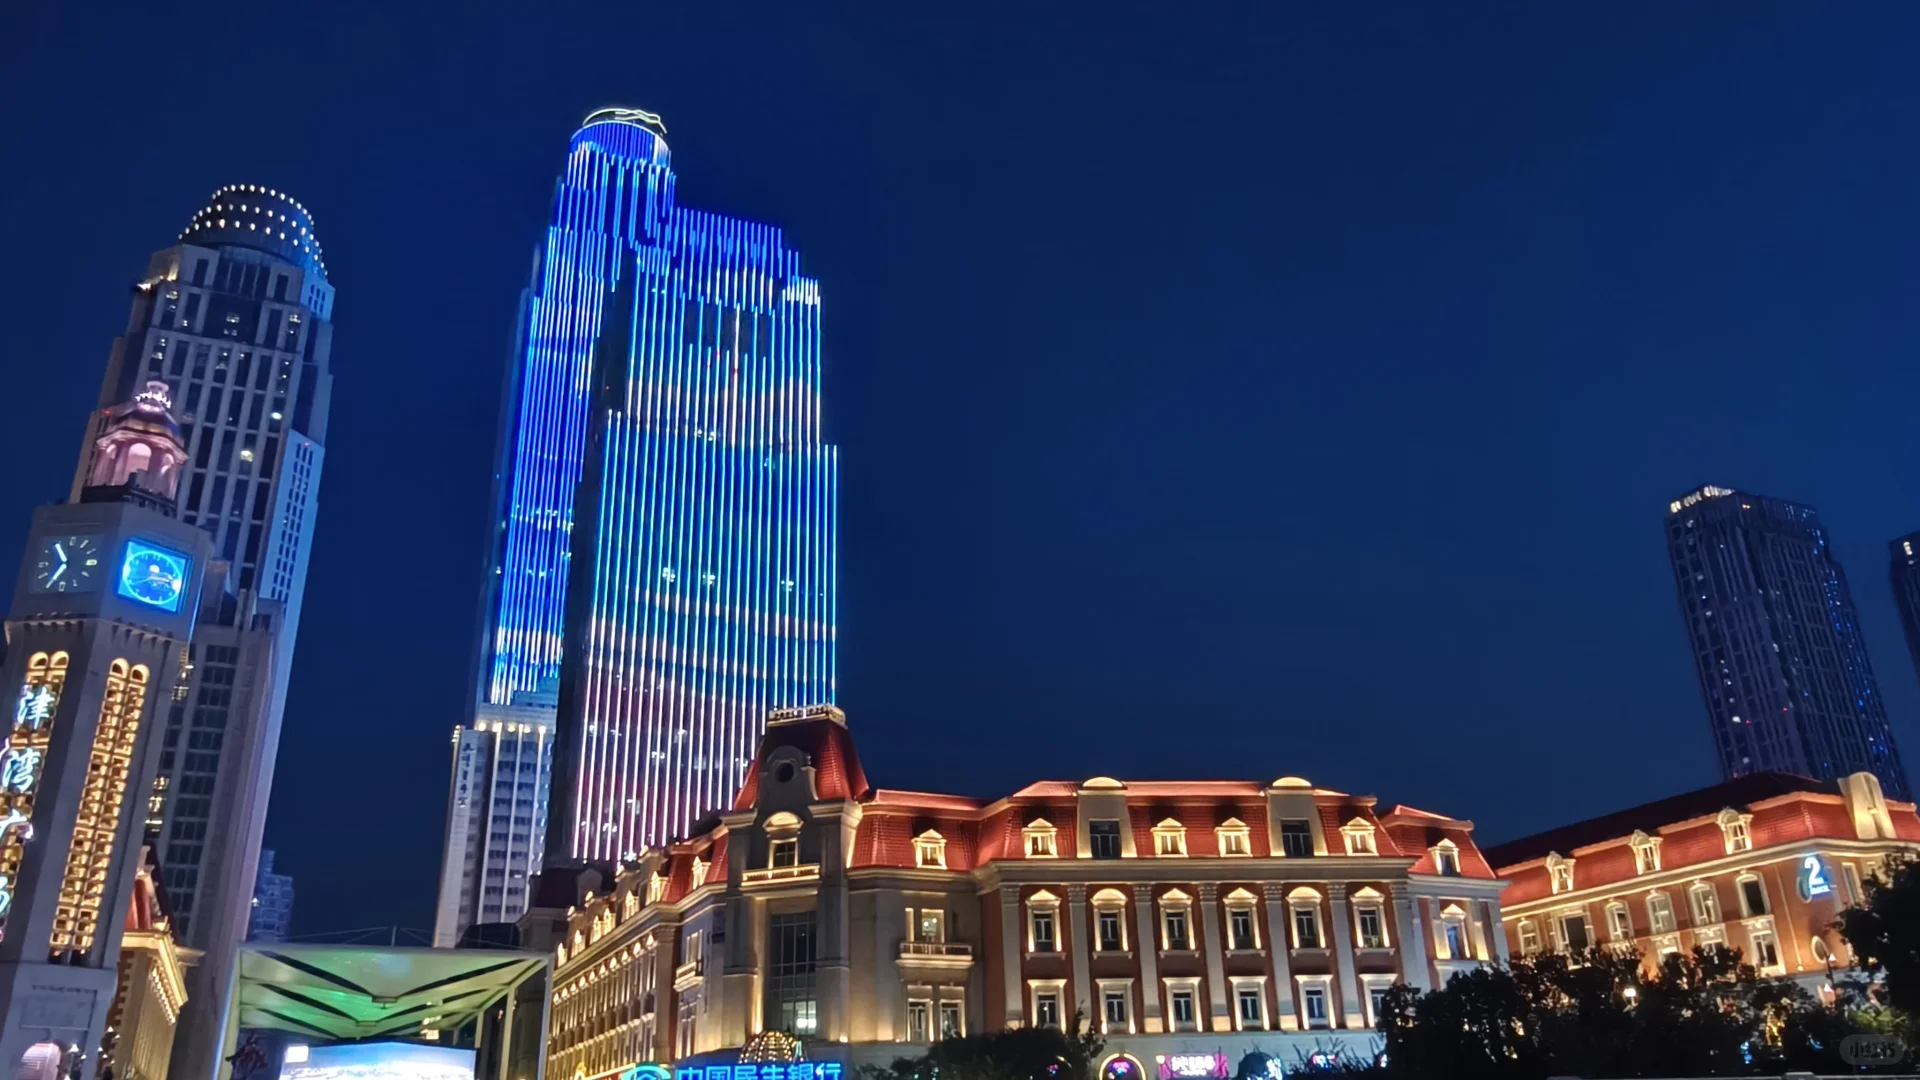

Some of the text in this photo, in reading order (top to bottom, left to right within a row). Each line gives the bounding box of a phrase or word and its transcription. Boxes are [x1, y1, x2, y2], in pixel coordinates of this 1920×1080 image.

[0, 686, 55, 915] 津湾广
[1804, 856, 1825, 885] 2
